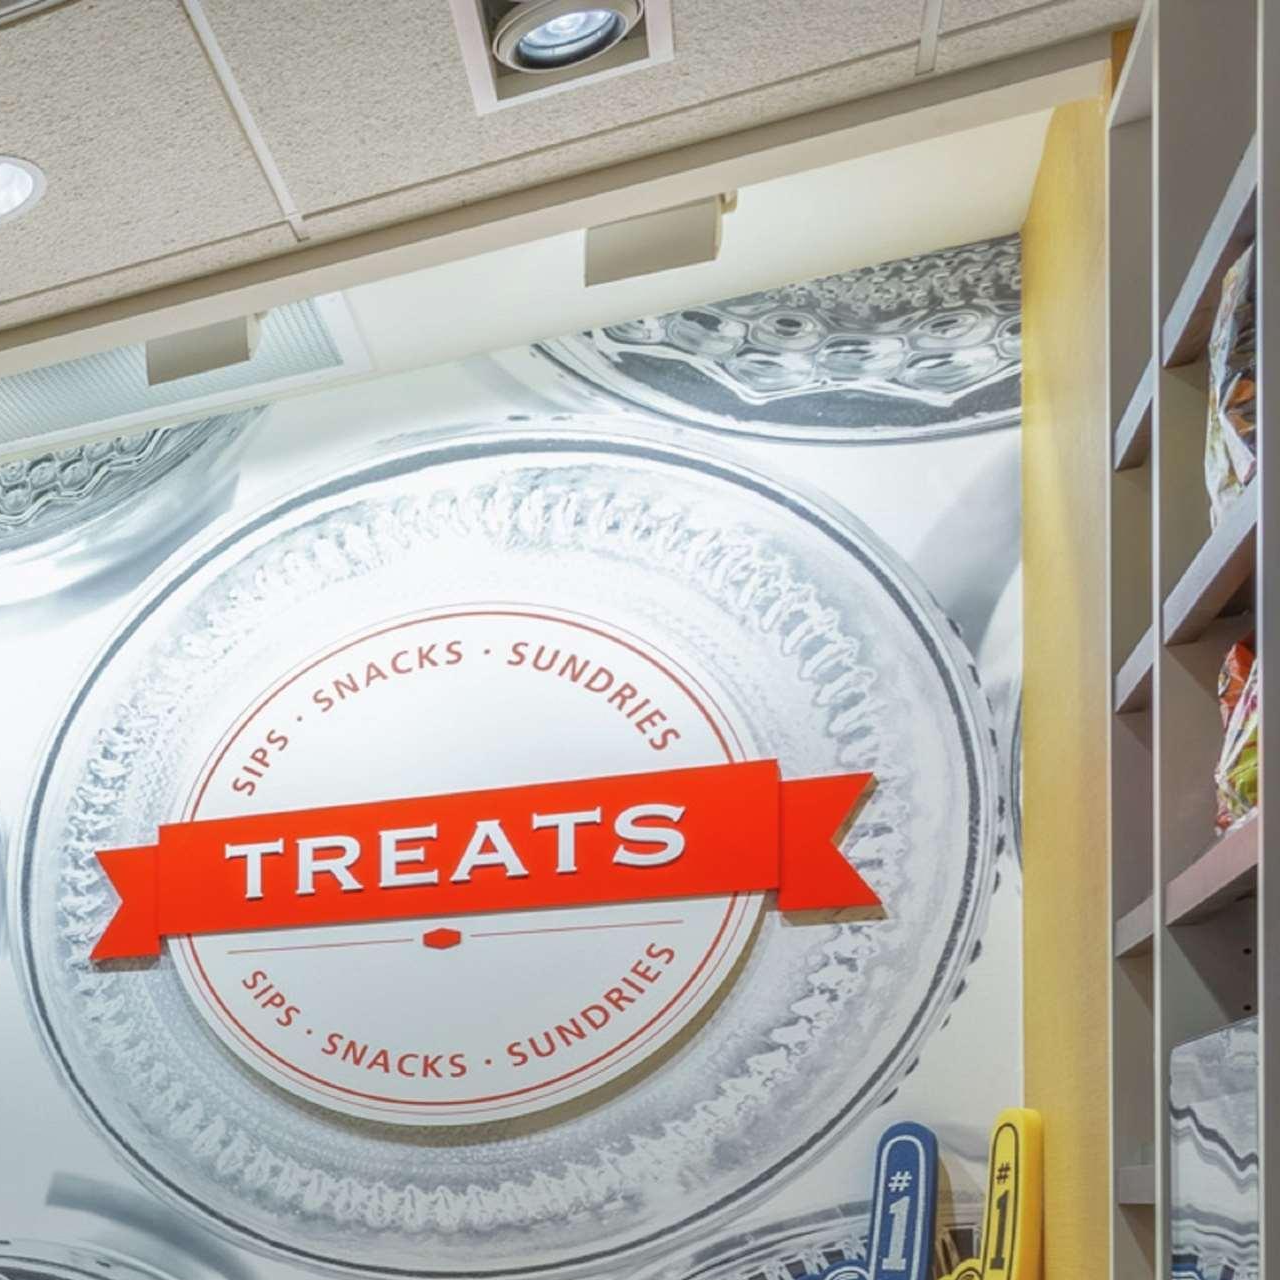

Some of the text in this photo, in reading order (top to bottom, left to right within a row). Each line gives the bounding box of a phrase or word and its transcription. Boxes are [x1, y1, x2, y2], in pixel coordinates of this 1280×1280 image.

[232, 640, 681, 797] SIPS SNACKS SUNDRIES
[224, 802, 687, 902] TREATS
[241, 940, 677, 1081] SIPS SNACKS SUNDRIES
[887, 1169, 913, 1194] #
[995, 1161, 1012, 1184] #
[880, 1191, 910, 1273] 1
[988, 1189, 1016, 1271] 1
